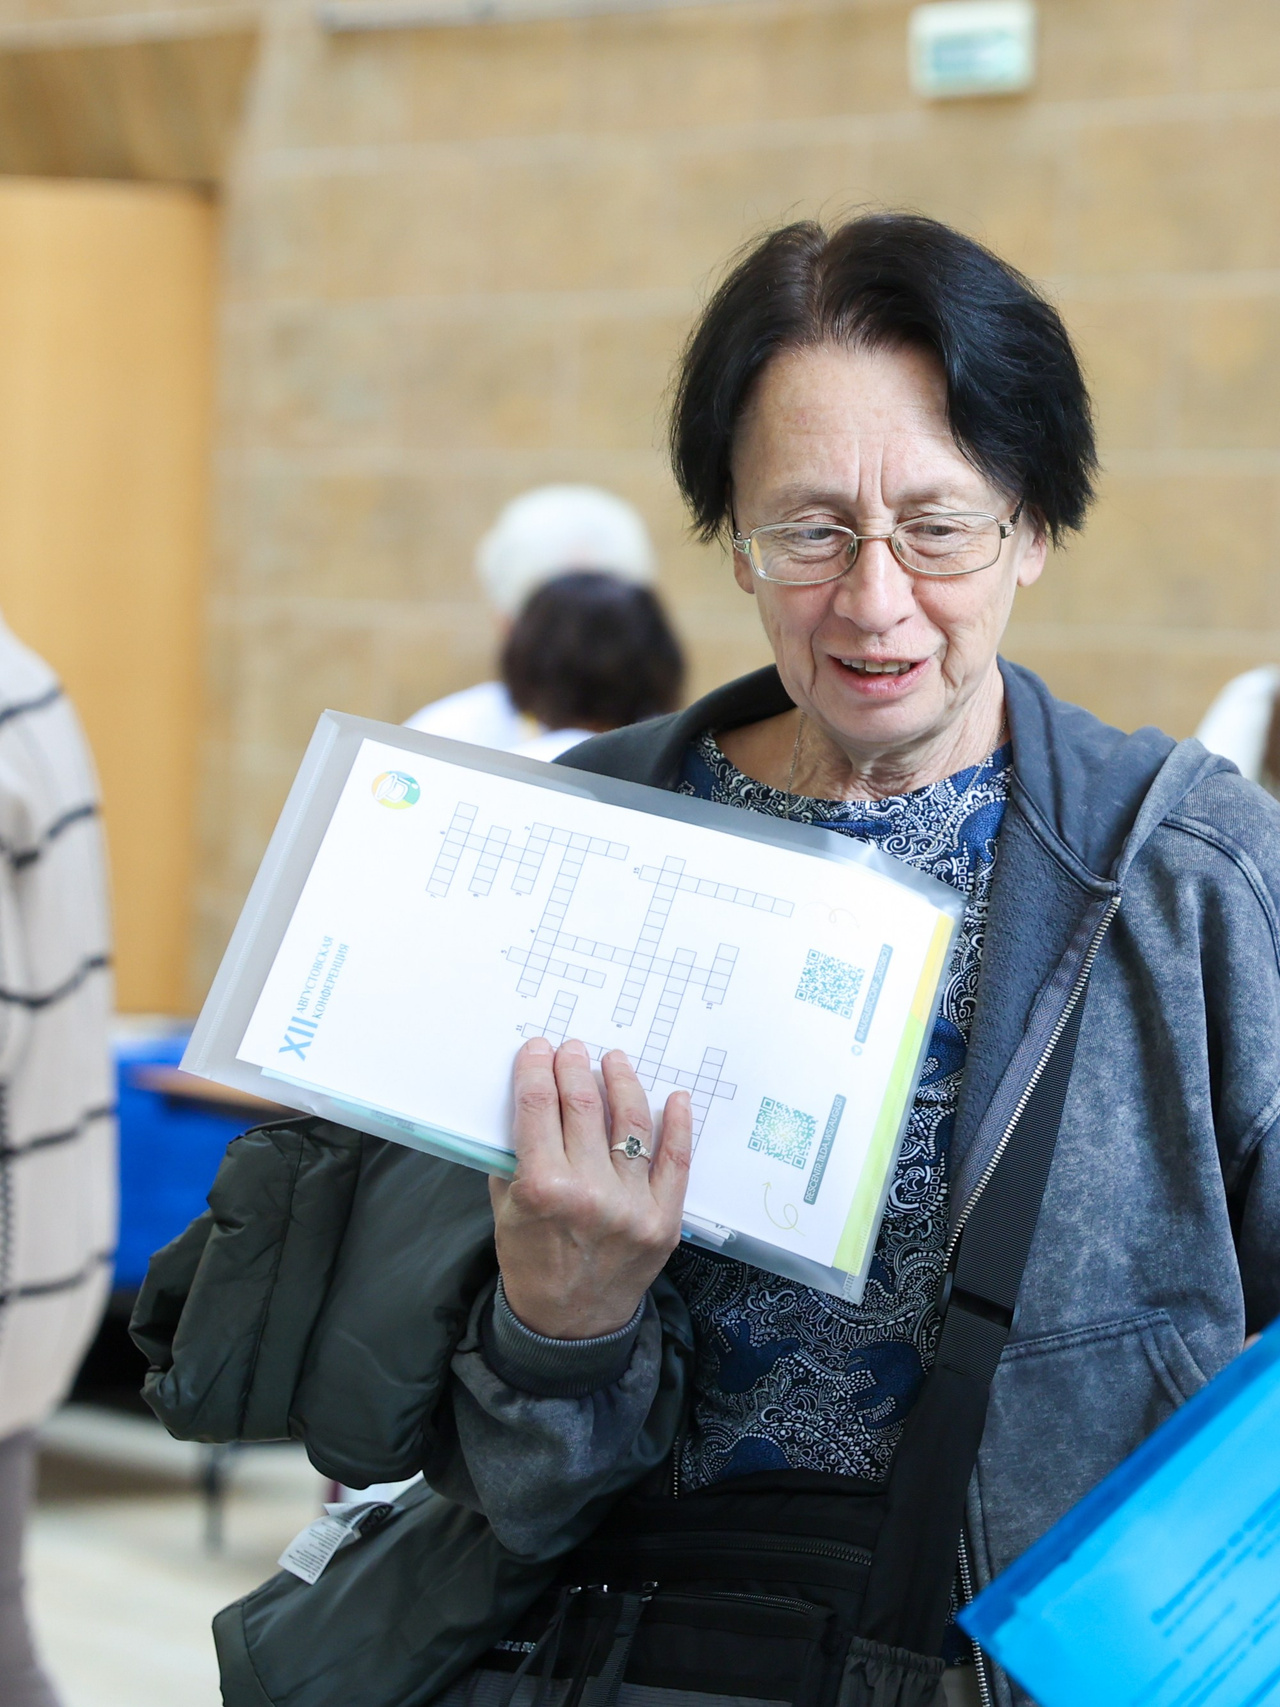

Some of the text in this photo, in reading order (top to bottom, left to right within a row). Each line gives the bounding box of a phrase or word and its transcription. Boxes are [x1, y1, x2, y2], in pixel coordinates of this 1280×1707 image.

[297, 936, 333, 1013] АВГУСТОВСКАЯ
[312, 943, 350, 1018] КОНФЕРЕНЦИЯ
[279, 1016, 318, 1061] XII
[806, 1096, 844, 1201] RESCENTR.TILDA.WS/AUGUST
